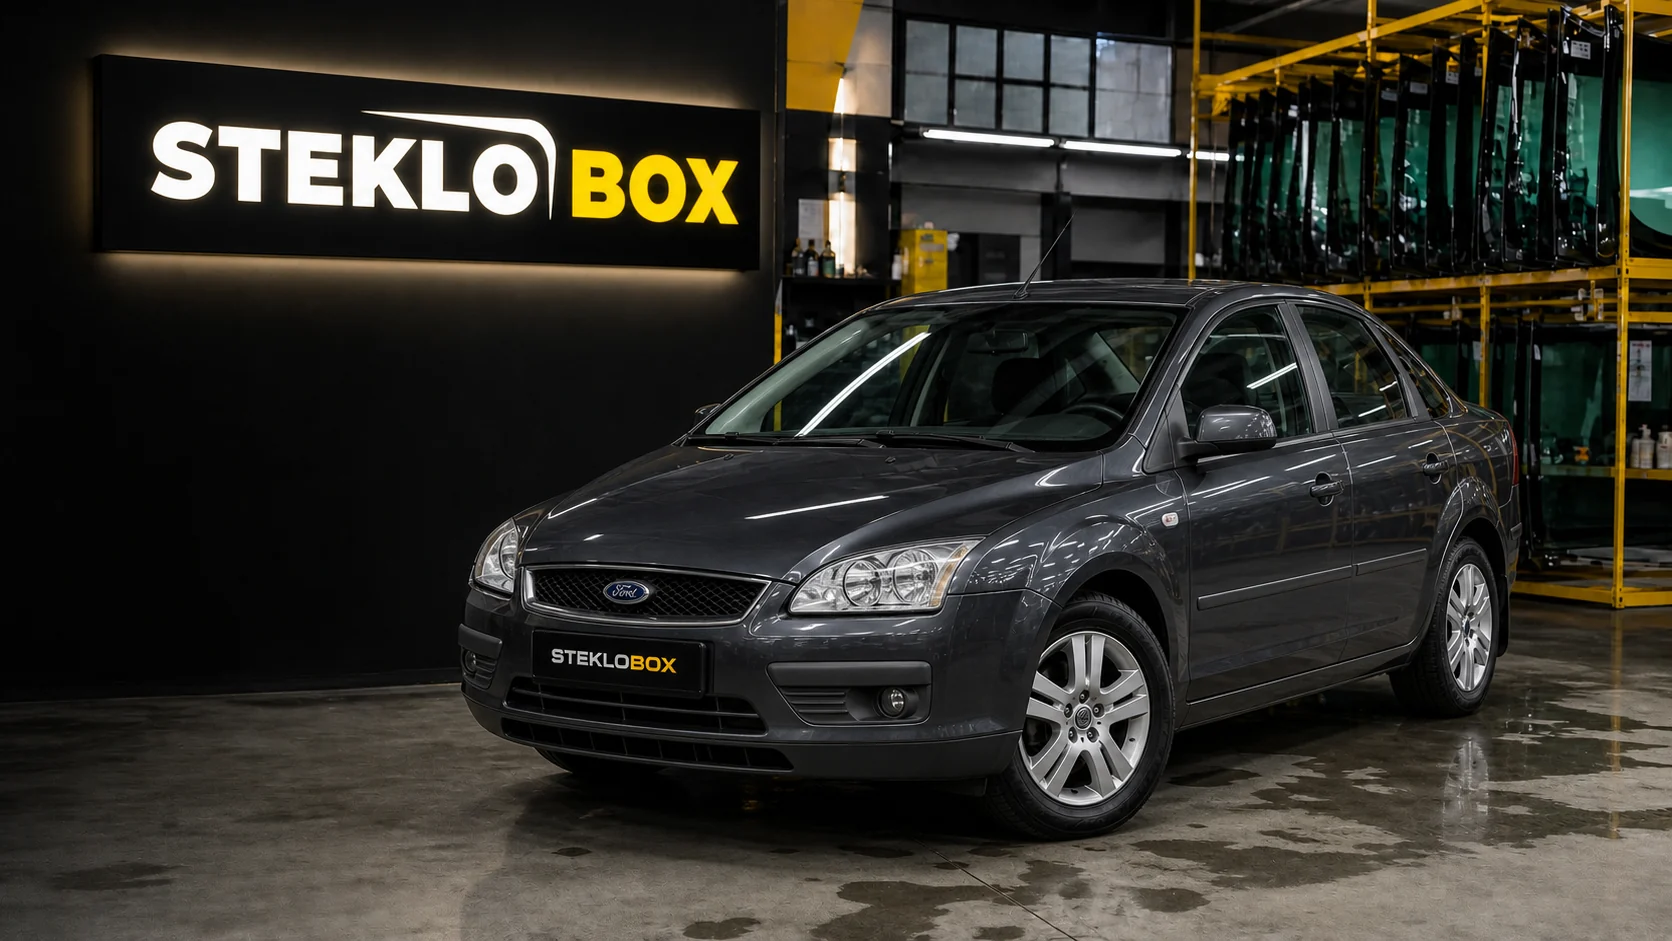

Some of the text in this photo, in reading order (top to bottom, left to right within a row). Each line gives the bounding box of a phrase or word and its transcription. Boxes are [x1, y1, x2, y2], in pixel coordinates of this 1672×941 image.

[151, 121, 738, 224] STEKLO BOX
[612, 584, 638, 598] Ford
[551, 648, 677, 674] STEKLOBOX
